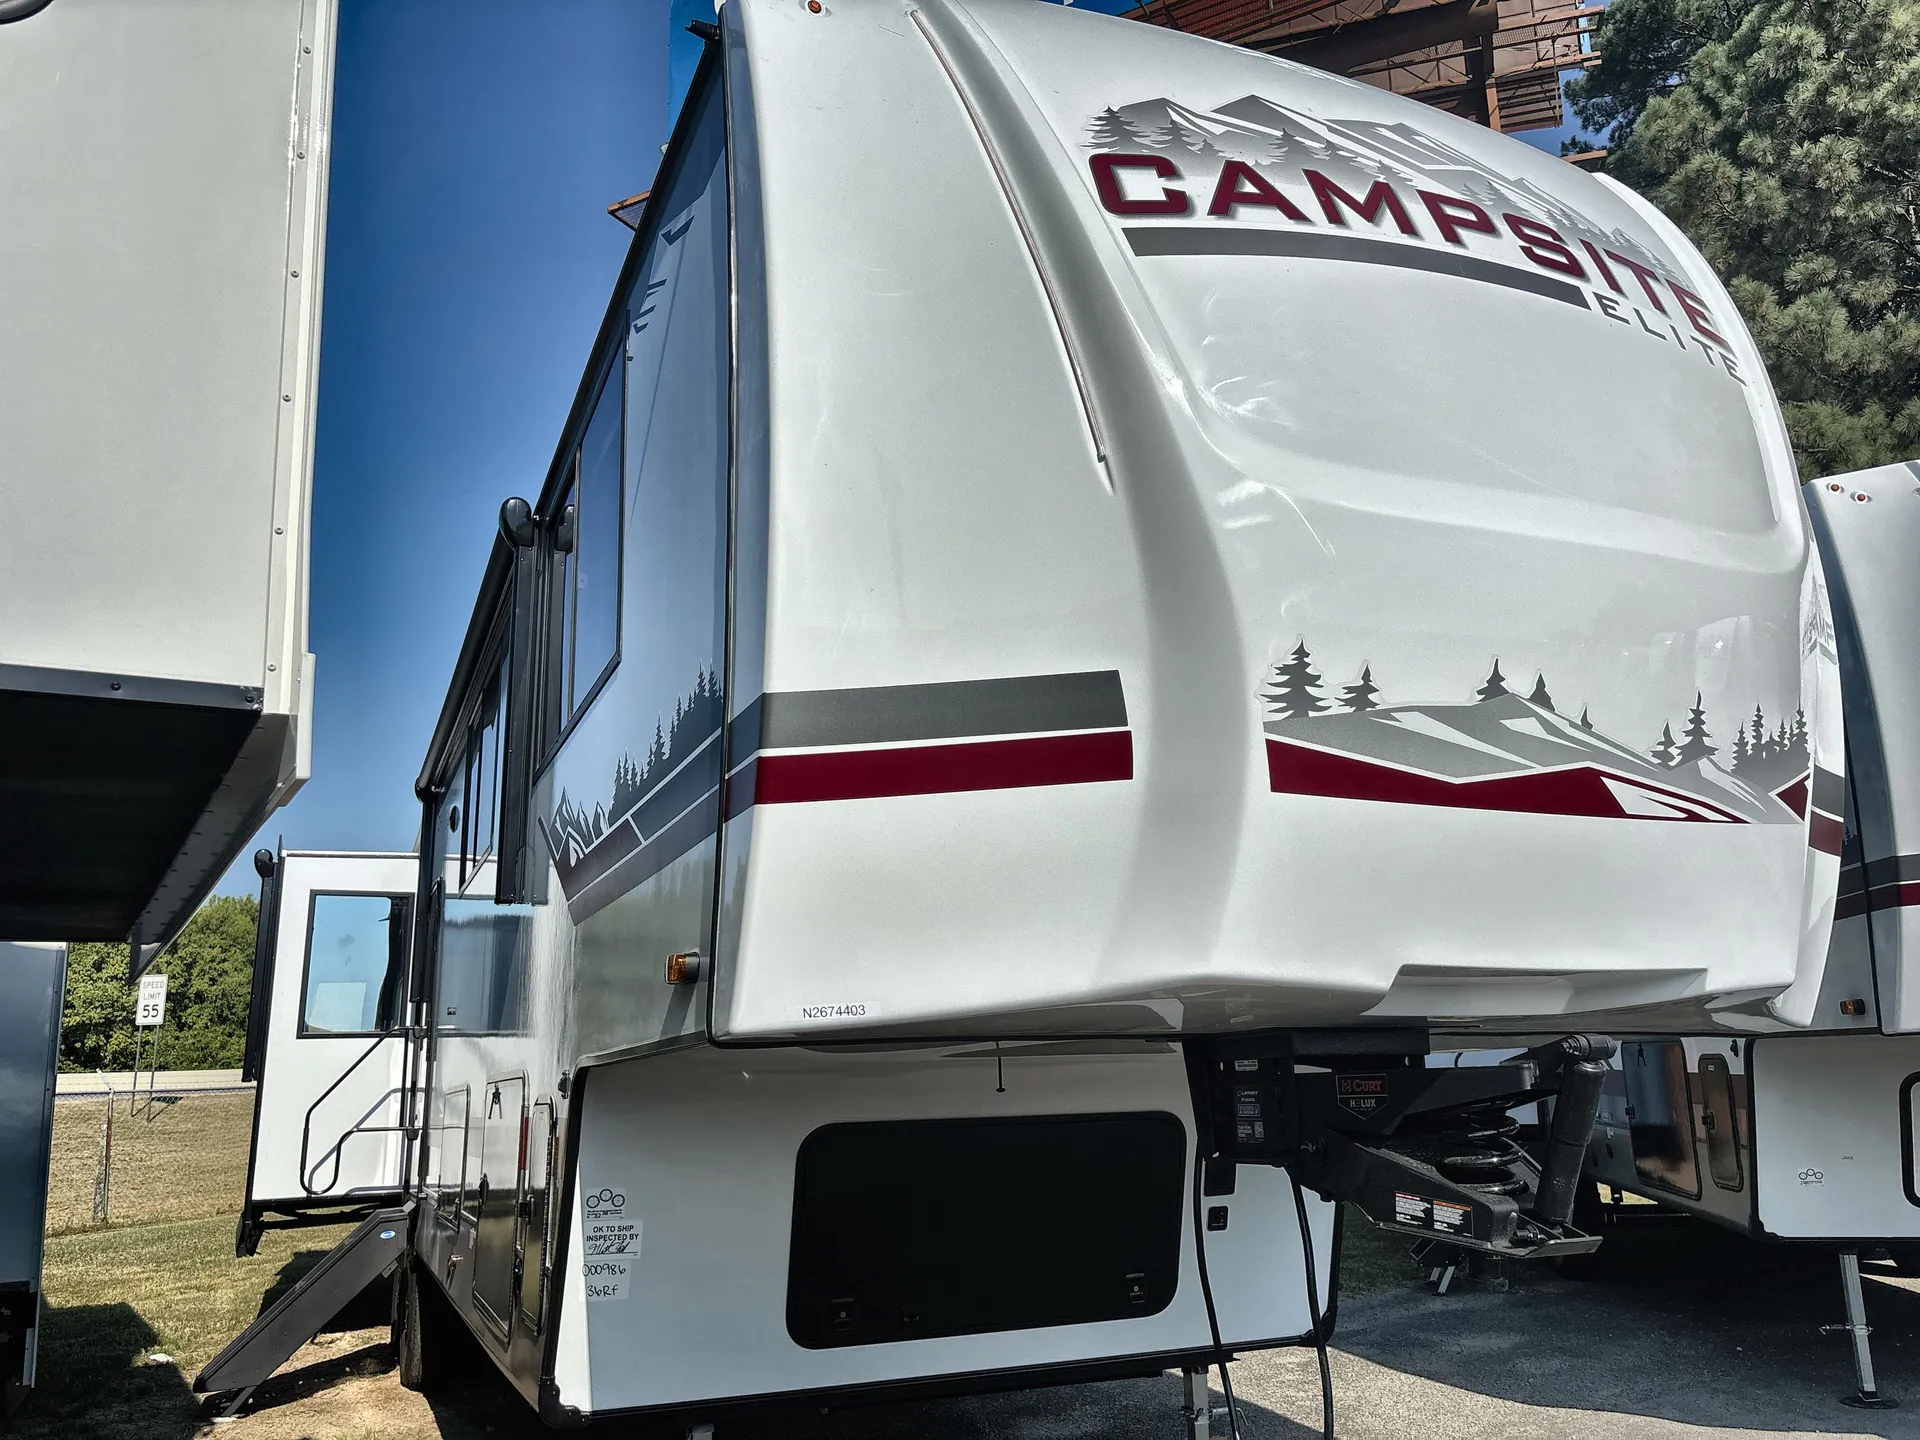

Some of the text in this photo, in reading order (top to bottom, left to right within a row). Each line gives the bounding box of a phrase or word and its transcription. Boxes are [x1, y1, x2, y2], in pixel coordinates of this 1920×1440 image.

[1088, 152, 1731, 352] CAMPSITE
[1592, 291, 1748, 387] ELITE
[142, 981, 164, 989] SPEED
[143, 992, 161, 1000] LIMIT
[142, 1004, 159, 1018] 55
[802, 1004, 866, 1018] N2674403
[606, 1225, 615, 1233] TO
[617, 1224, 634, 1232] SHIP
[586, 1233, 640, 1242] INSPECTED BY
[582, 1263, 627, 1277] 000986
